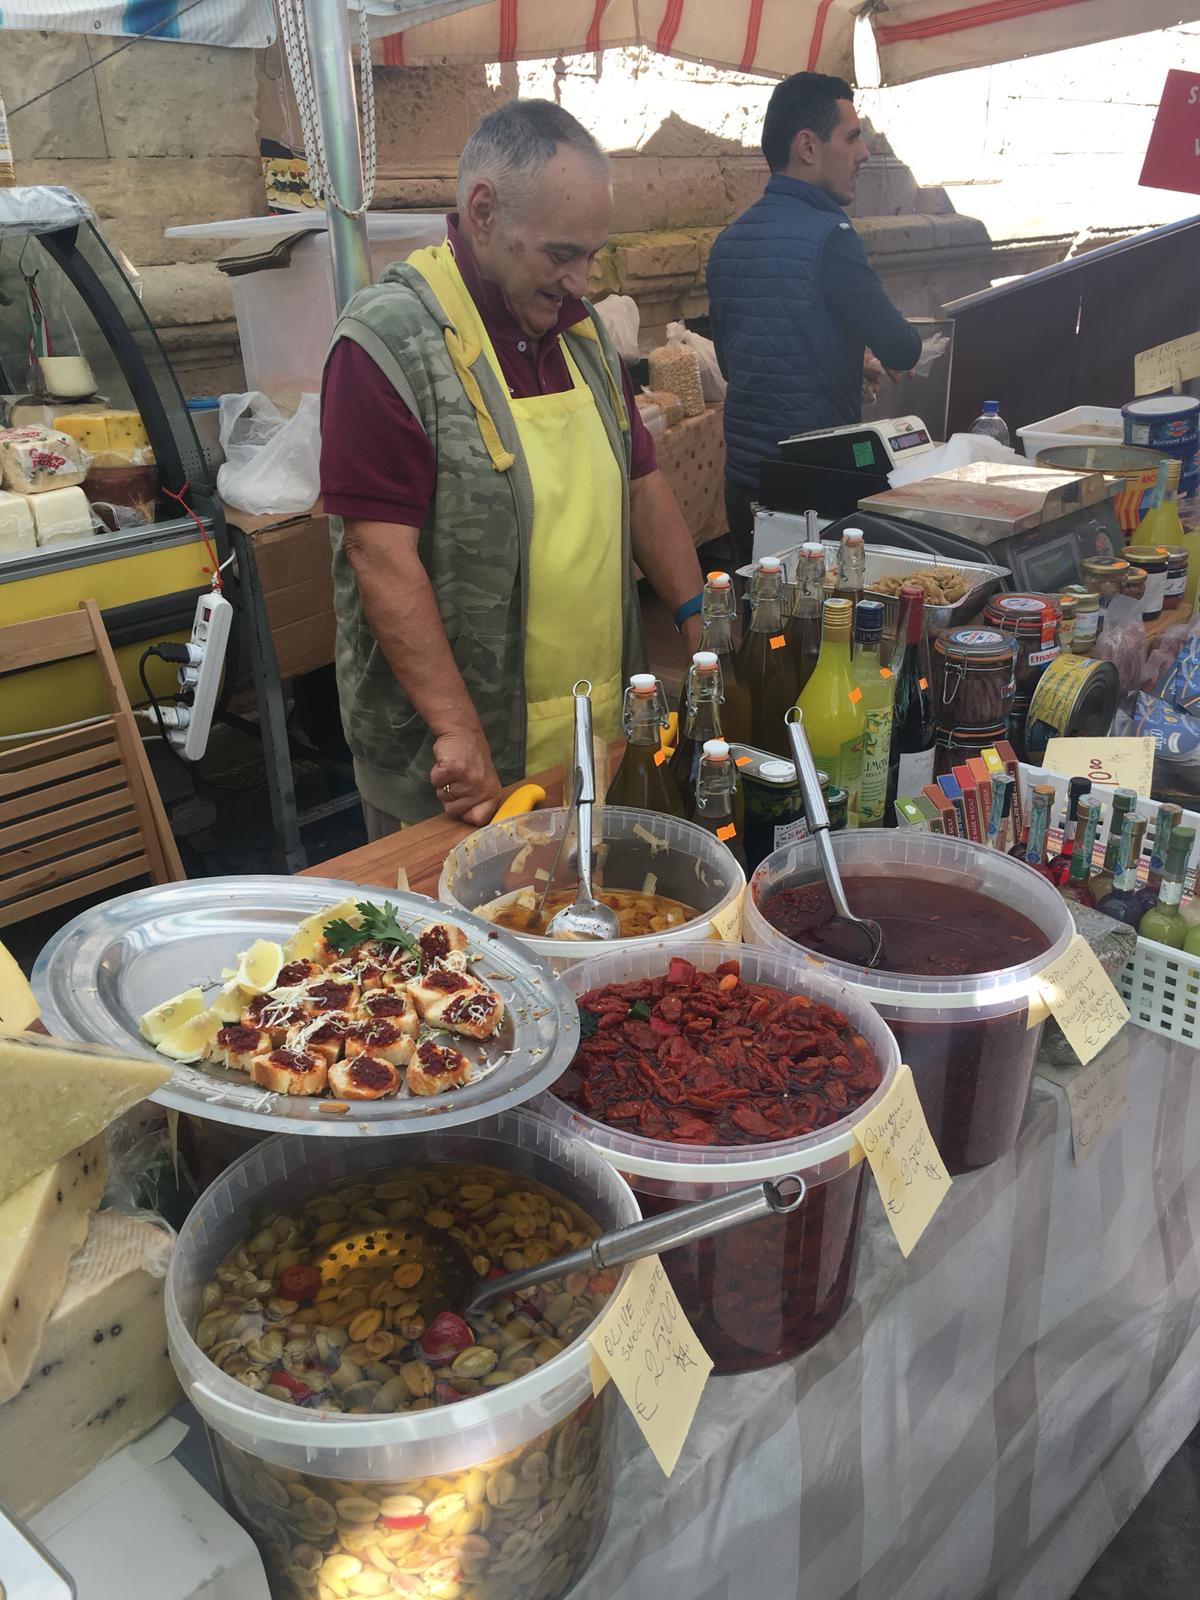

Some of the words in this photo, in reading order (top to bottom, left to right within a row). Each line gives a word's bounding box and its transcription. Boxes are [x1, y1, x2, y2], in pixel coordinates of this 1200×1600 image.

[603, 1298, 634, 1357] OLIVE
[620, 1264, 664, 1362] SNOCCIOLATE
[634, 1374, 659, 1422] €
